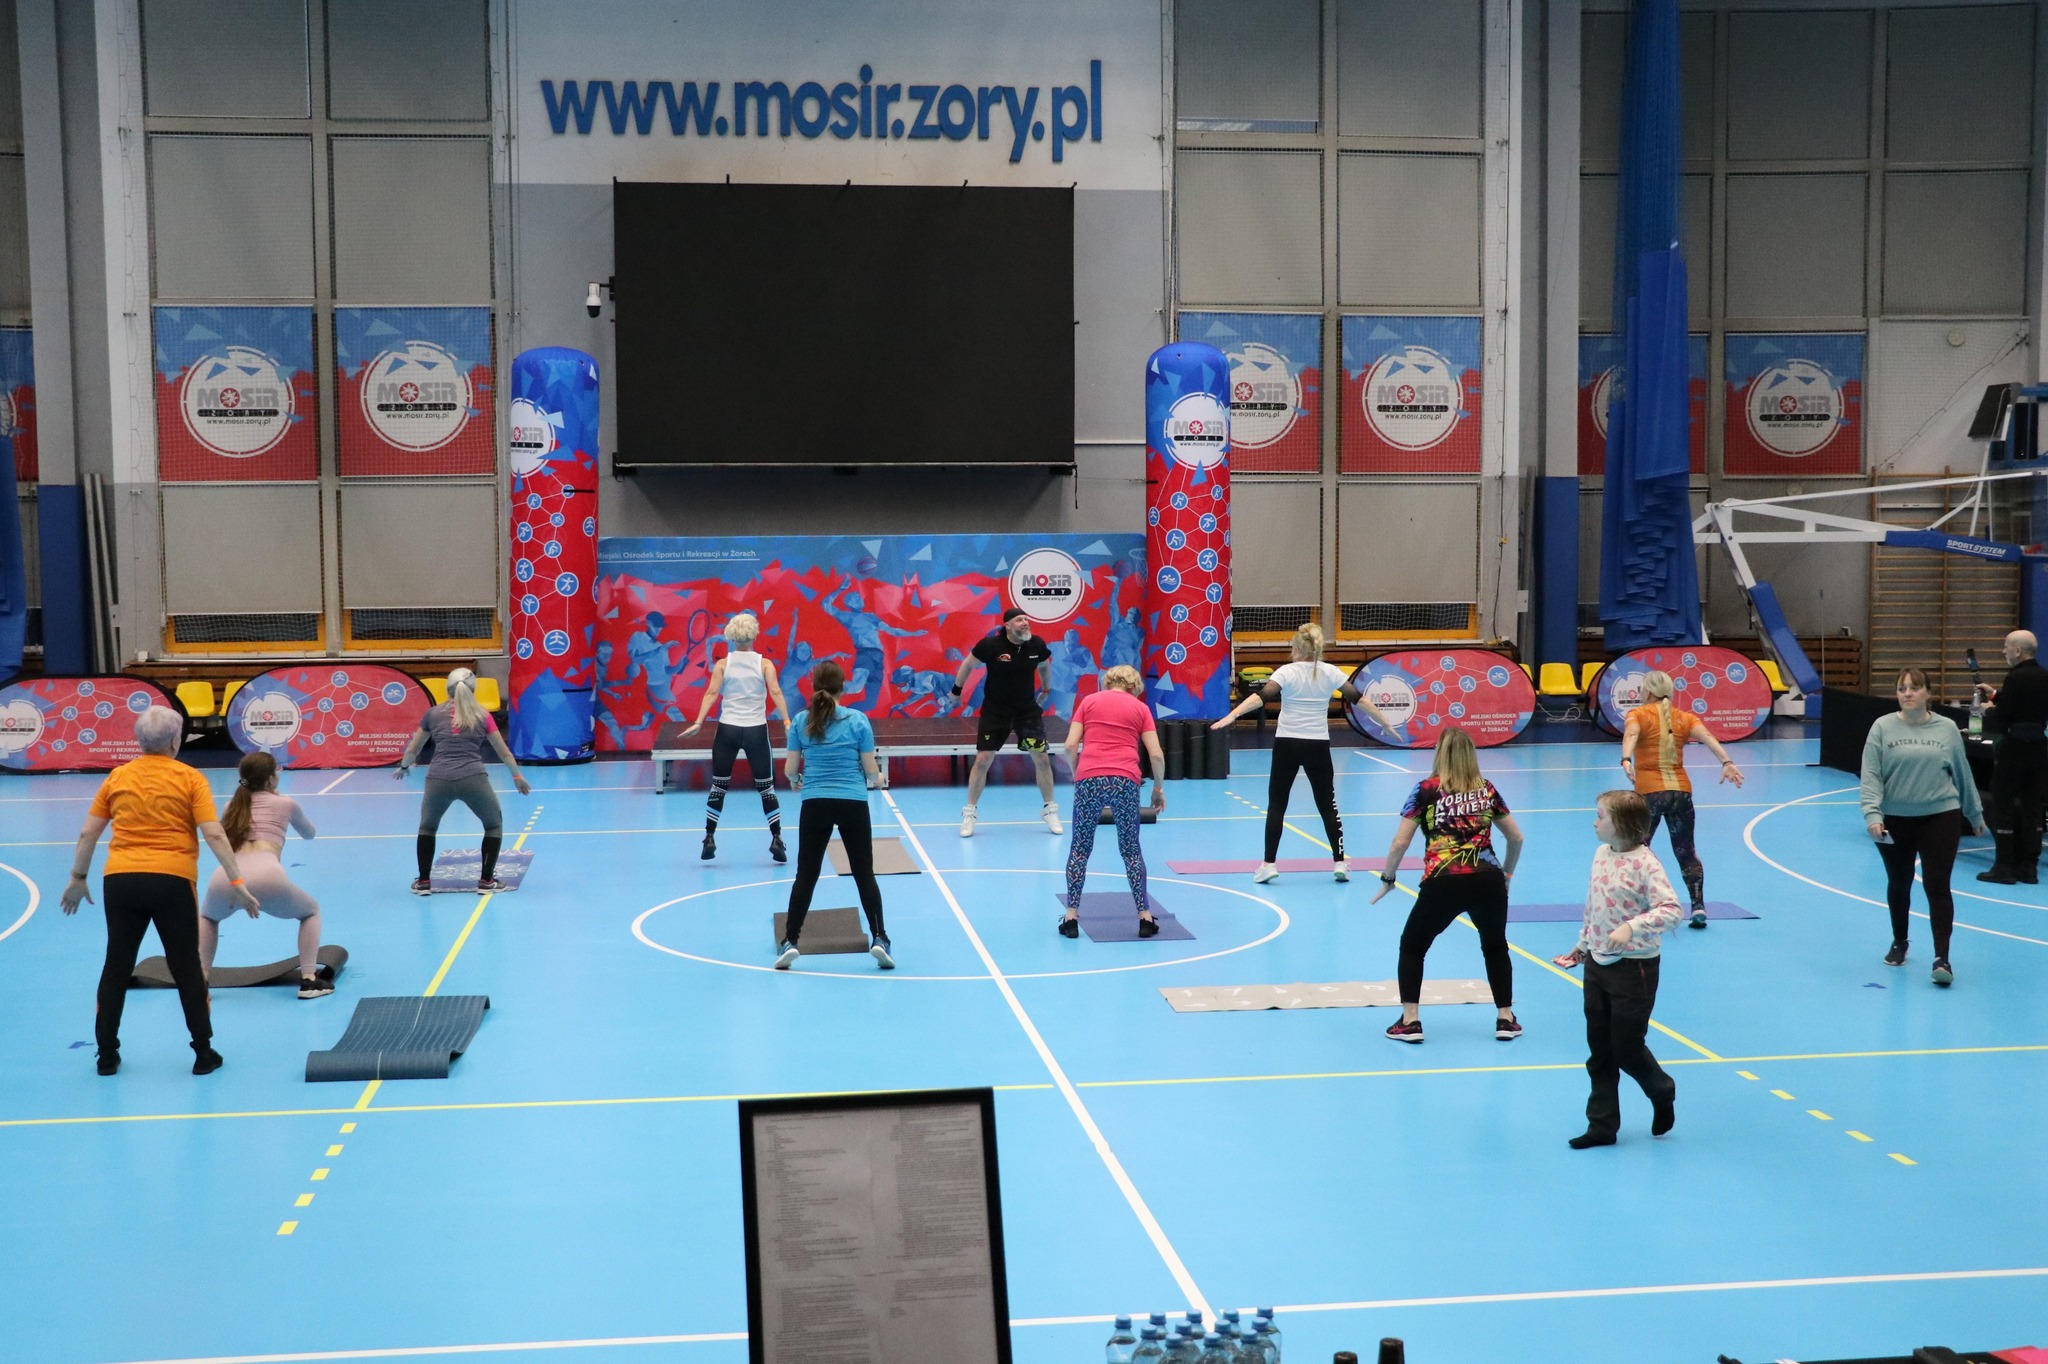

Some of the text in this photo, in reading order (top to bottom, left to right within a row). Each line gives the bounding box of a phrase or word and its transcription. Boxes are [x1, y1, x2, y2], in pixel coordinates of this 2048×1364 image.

[541, 59, 1102, 163] www.mosir.zory.pl
[623, 551, 655, 559] Ośrodek
[656, 551, 681, 560] Sportu
[687, 550, 721, 559] Rekreacji
[730, 549, 756, 557] Żorach
[1973, 544, 2006, 556] SYSTEM
[1887, 738, 1945, 750] MATCHA LATTE
[1436, 788, 1489, 814] KOBIETA
